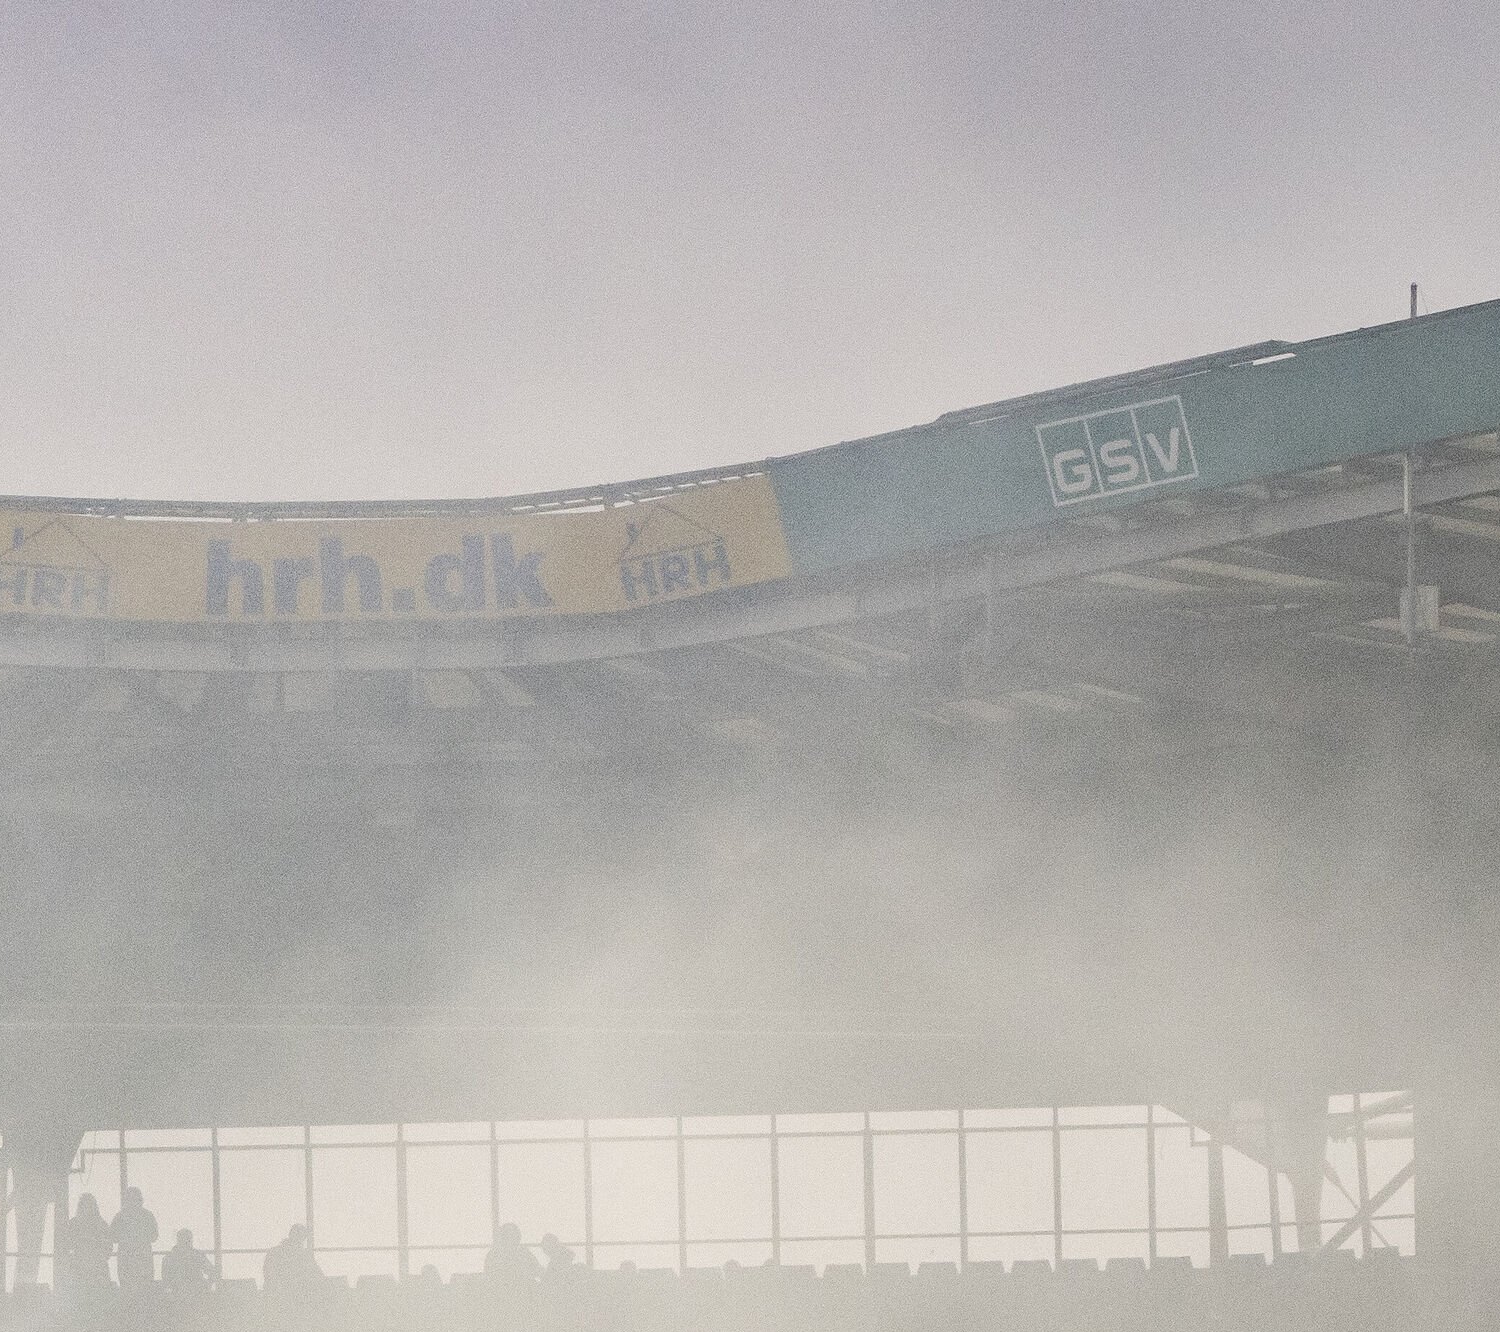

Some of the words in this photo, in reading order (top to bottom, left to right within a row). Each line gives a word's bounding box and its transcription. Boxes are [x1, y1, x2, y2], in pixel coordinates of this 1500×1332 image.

[1051, 426, 1180, 495] GSV
[205, 531, 556, 616] hrh.dk
[620, 535, 732, 601] HRH
